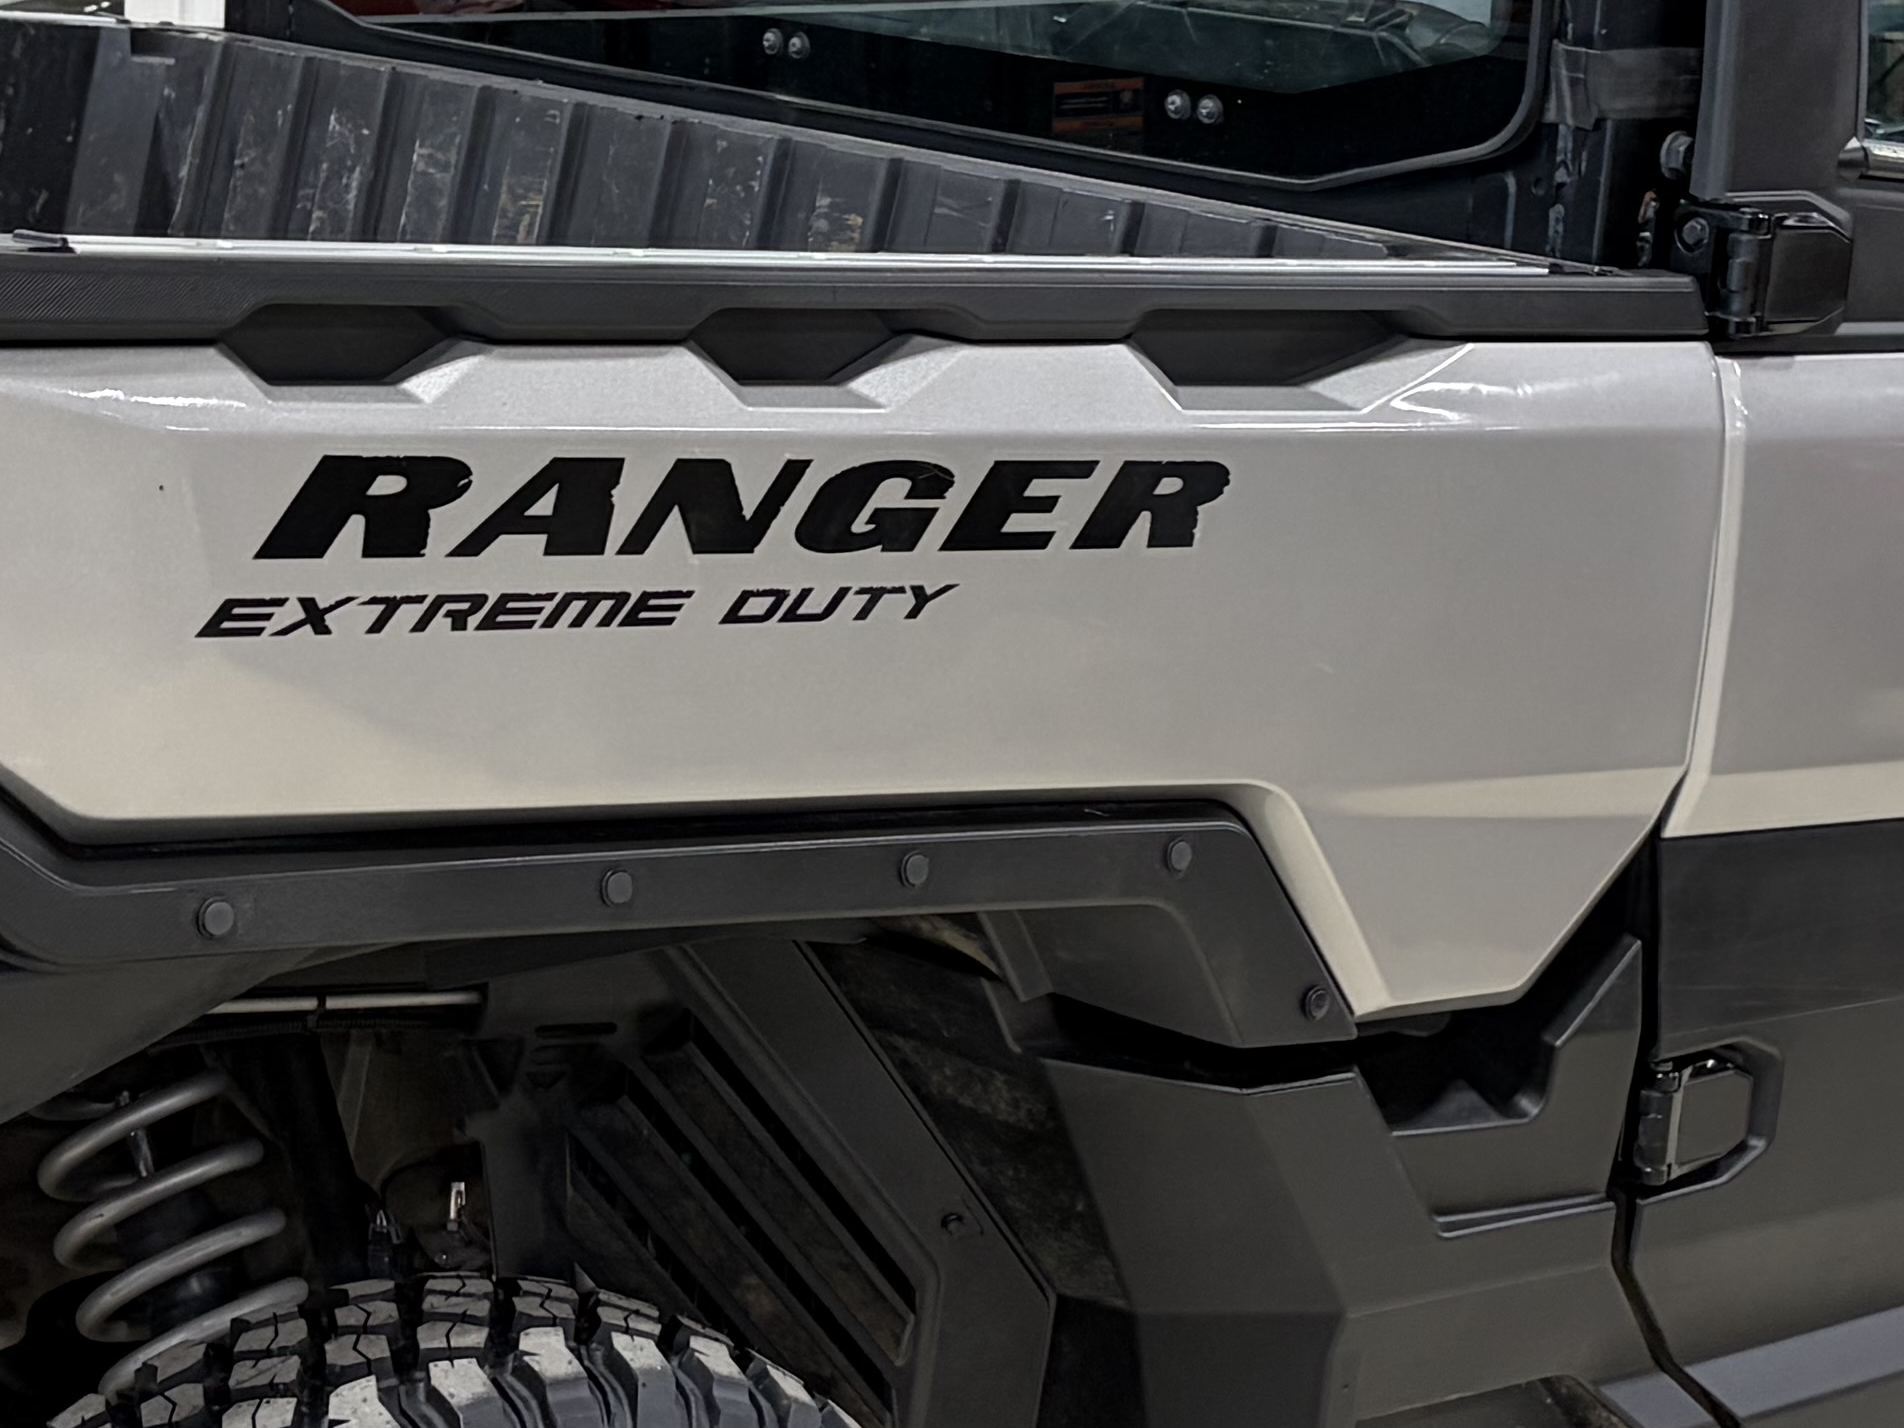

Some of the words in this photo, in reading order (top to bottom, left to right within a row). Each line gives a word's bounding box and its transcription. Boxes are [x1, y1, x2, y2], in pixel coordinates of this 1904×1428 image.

[252, 453, 1232, 560] RANGER
[194, 587, 694, 639] EXTREME
[719, 583, 960, 627] DUTY
